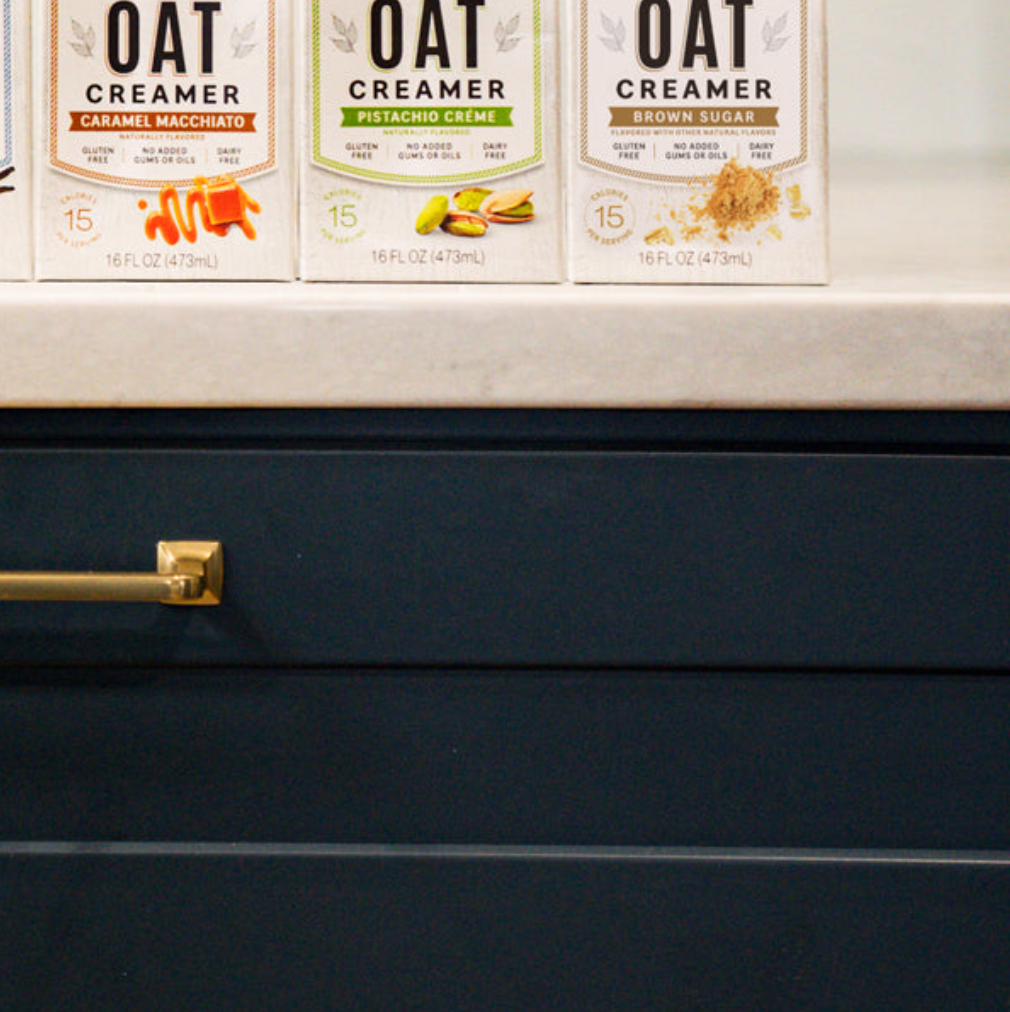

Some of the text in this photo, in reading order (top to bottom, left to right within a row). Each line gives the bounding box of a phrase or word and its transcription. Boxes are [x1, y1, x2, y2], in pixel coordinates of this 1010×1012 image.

[105, 0, 222, 77] OAT
[86, 84, 239, 104] CREAMER
[349, 79, 505, 100] CREAMER
[617, 79, 772, 100] CREAMER
[80, 114, 245, 128] CARAMEL MACCHIATO
[358, 108, 496, 123] PISTACHIO CRÉME
[634, 111, 755, 123] BROWN SUGAR
[88, 156, 108, 164] FREE
[134, 156, 195, 164] GUMS OR OILS
[219, 157, 240, 165] FREE
[64, 209, 93, 231] 15
[329, 205, 357, 227] 15
[595, 206, 624, 228] 15
[107, 253, 218, 268] 16 FL OZ (473mL)
[372, 250, 485, 265] 16 FL OZ (473mL)
[639, 251, 752, 267] 16 FL OZ (473mL)
